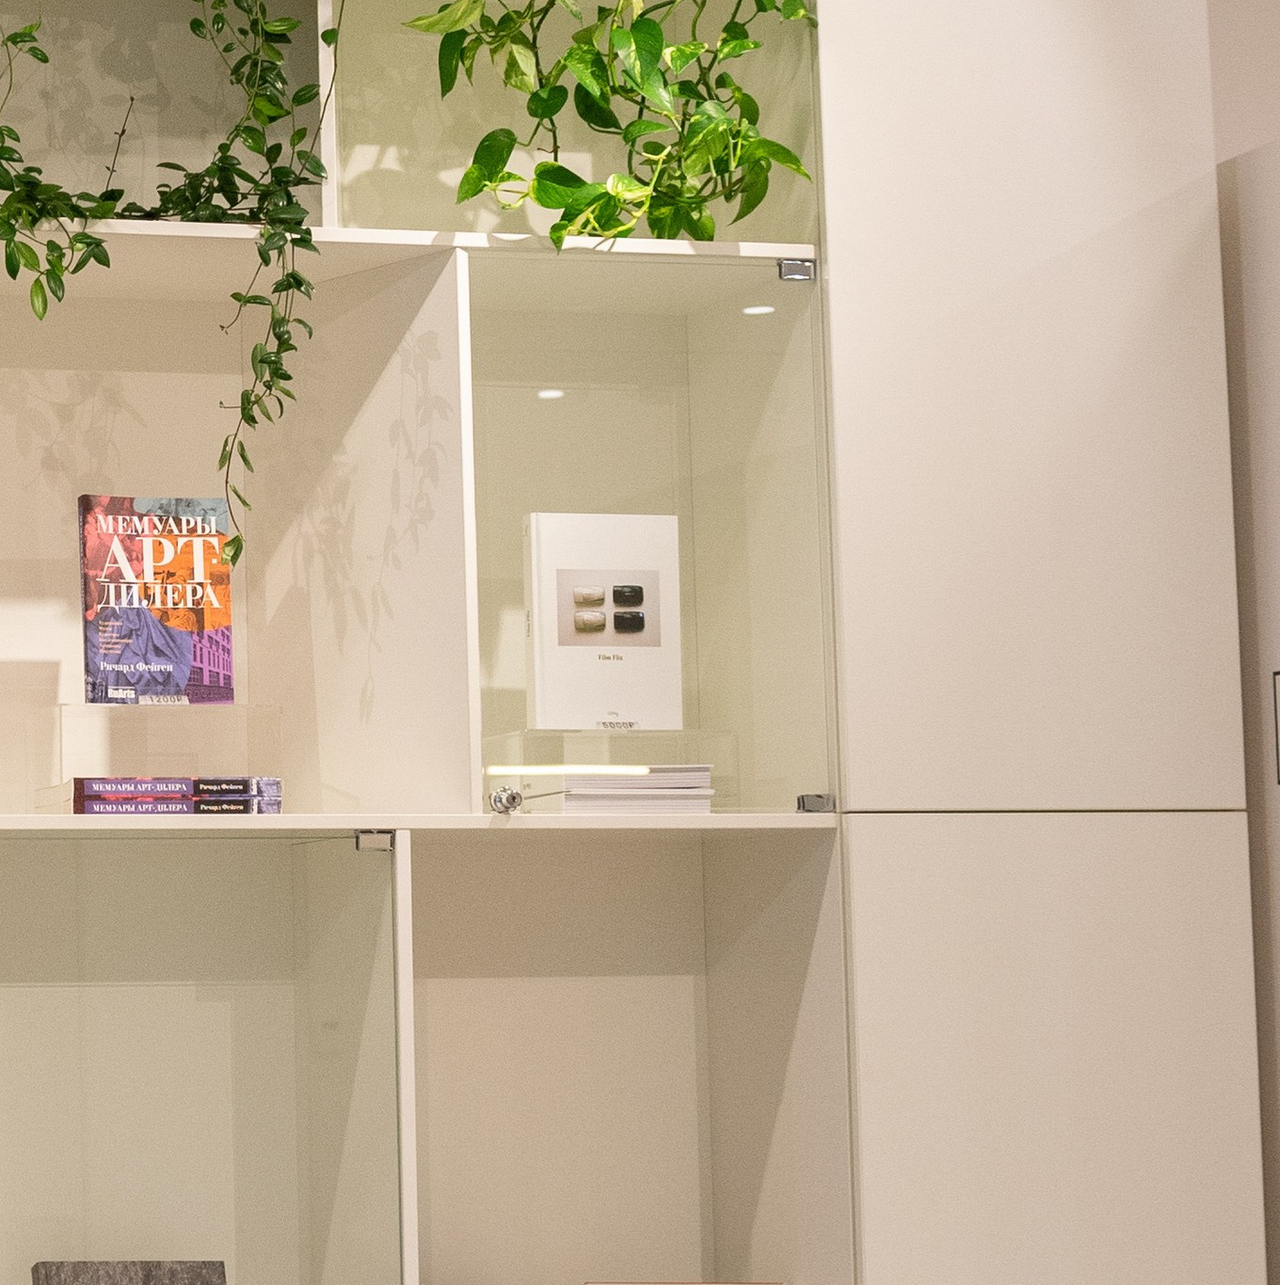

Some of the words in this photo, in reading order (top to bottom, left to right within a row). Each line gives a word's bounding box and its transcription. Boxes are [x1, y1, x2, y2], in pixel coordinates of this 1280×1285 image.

[96, 514, 217, 536] МЕМУАРЫ
[96, 535, 220, 583] АРТ-
[96, 582, 222, 612] ДИЛЕРА
[100, 661, 135, 673] Ричард
[136, 661, 173, 672] Фейген
[92, 783, 136, 791] МЕМУАРЫ
[92, 804, 137, 812] МЕМУАРЫ
